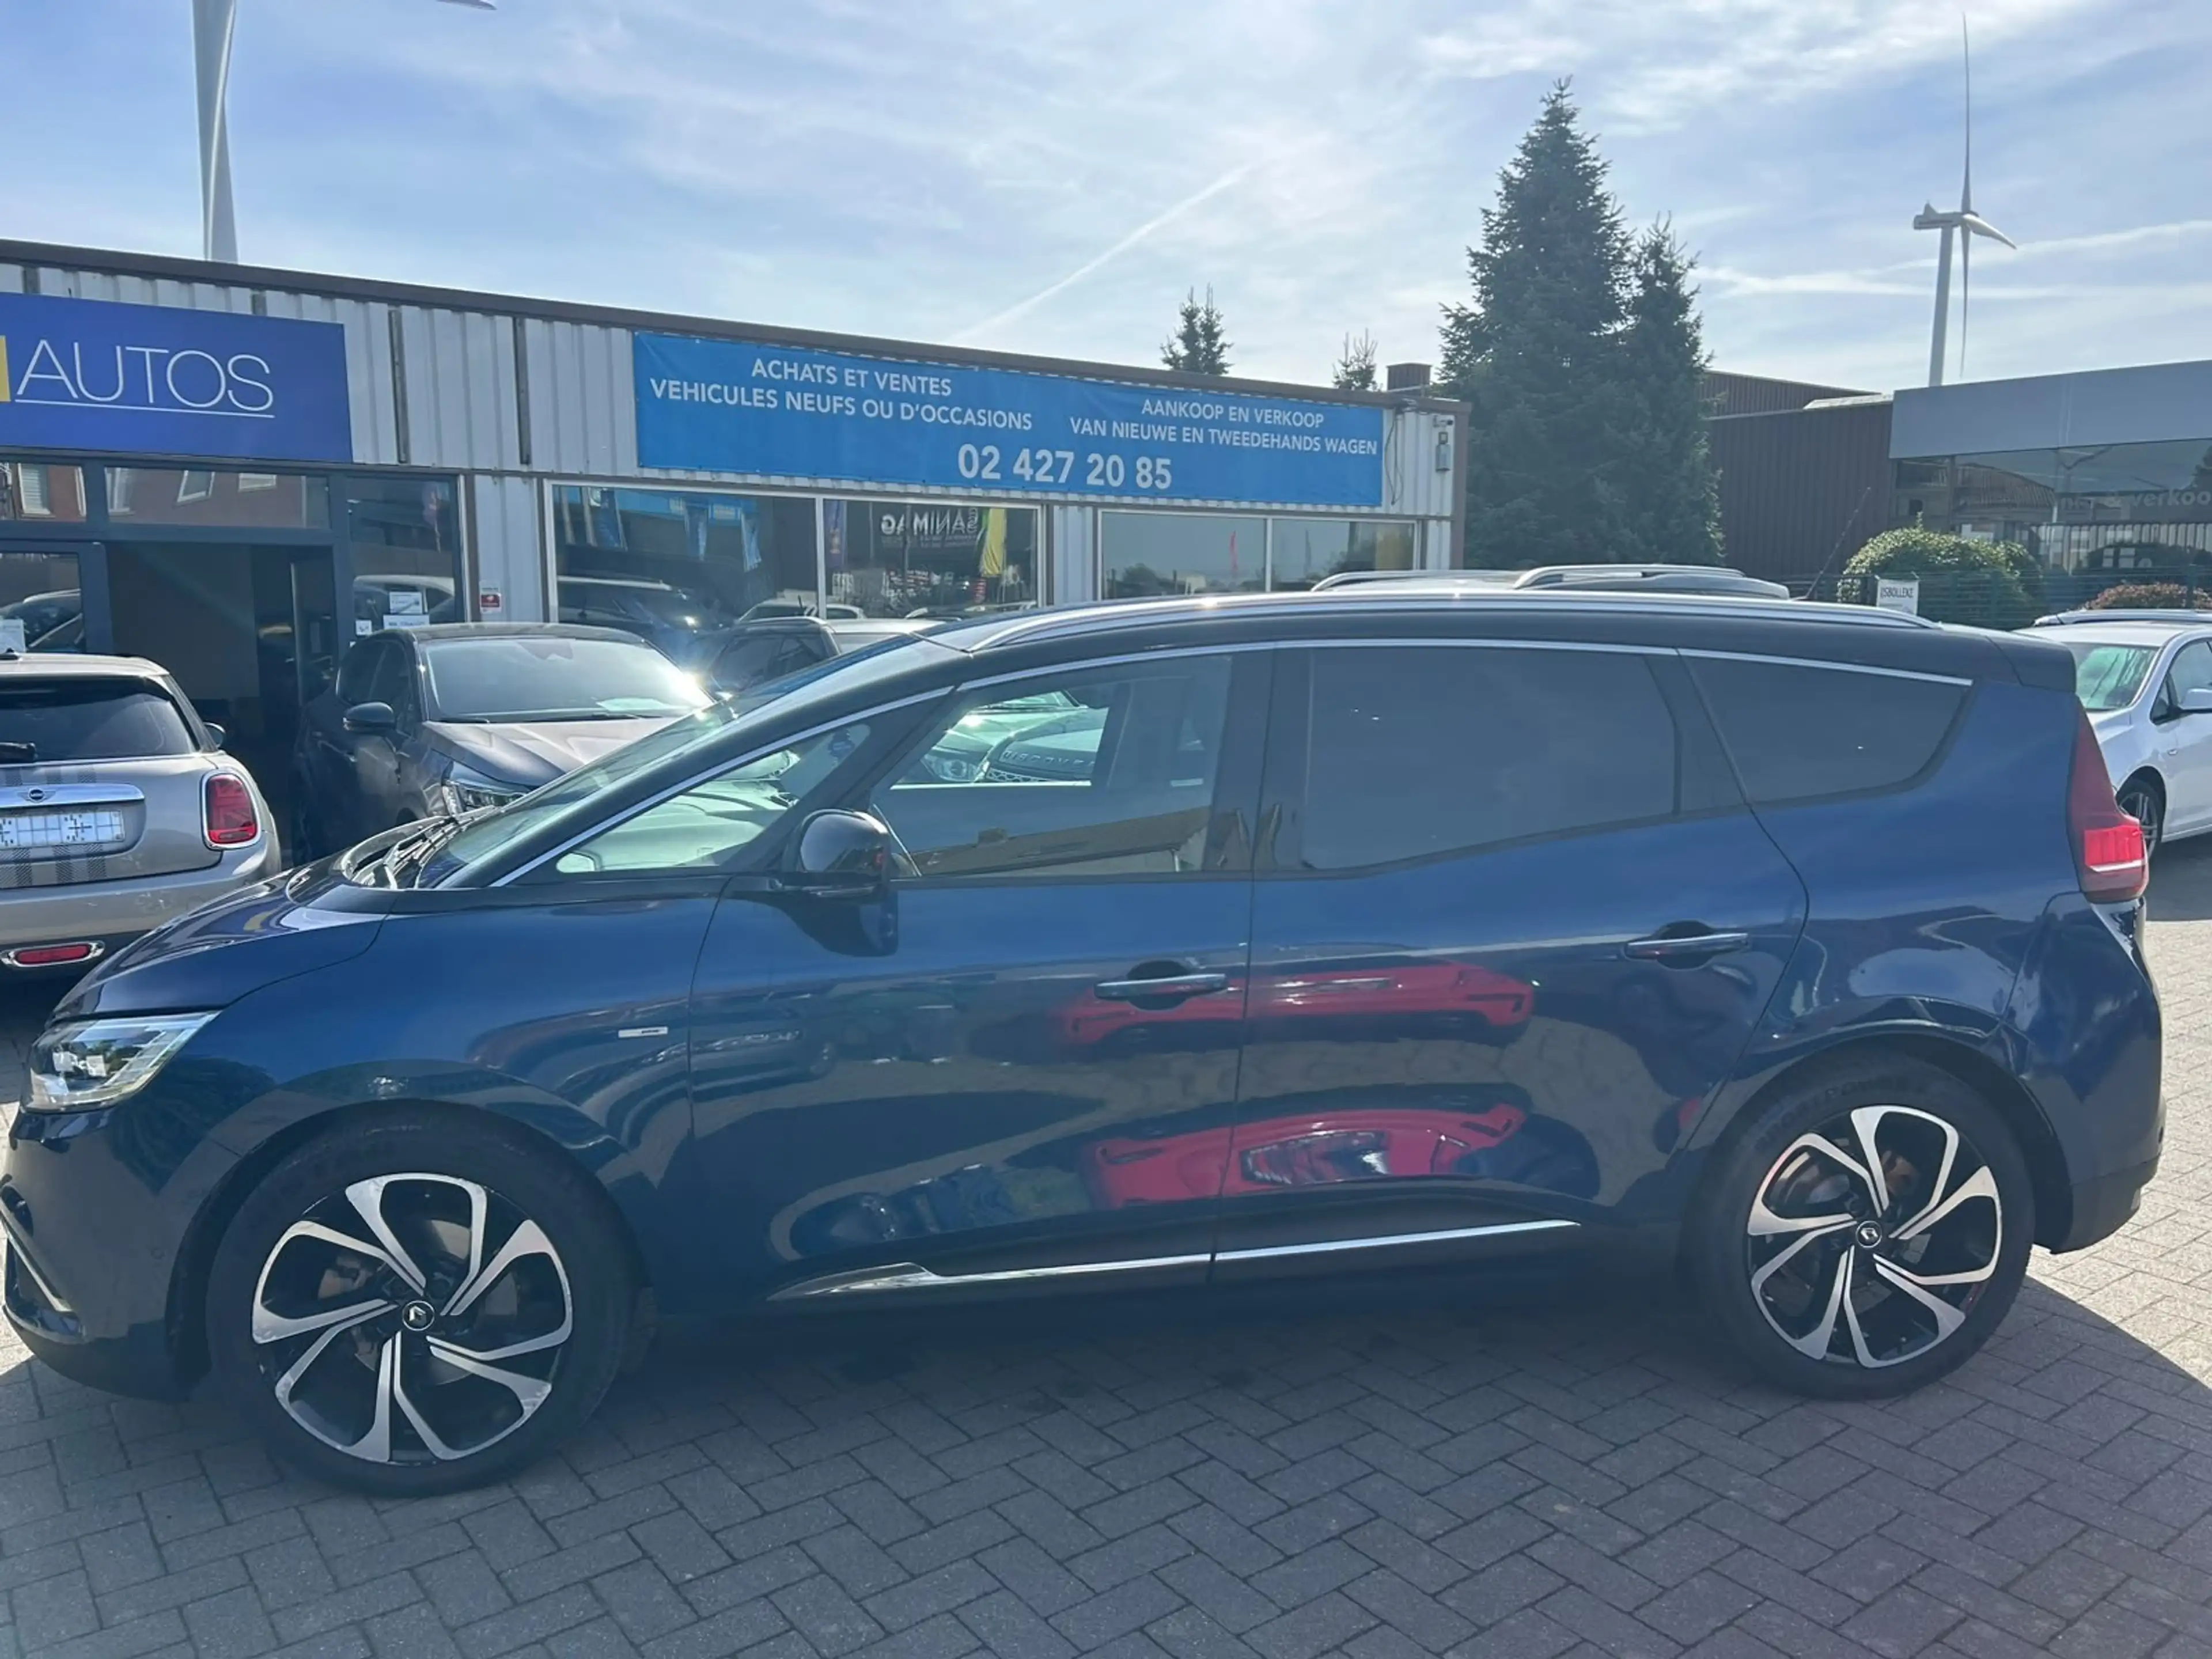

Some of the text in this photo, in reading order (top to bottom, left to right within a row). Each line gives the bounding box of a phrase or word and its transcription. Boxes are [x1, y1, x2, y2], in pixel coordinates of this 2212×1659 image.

[16, 339, 275, 412] AUTOS
[752, 358, 952, 397] ACHATS ET VENTES
[650, 378, 1032, 430] VEHICULES NEUFS OU D'OCCASIONS
[1141, 397, 1324, 428] AANKOOP EN VERKOOP
[1070, 417, 1377, 454] VAN NIEUWE EN TWEEDEHANDS WAGEN
[958, 444, 1172, 490] 02 427 20 85
